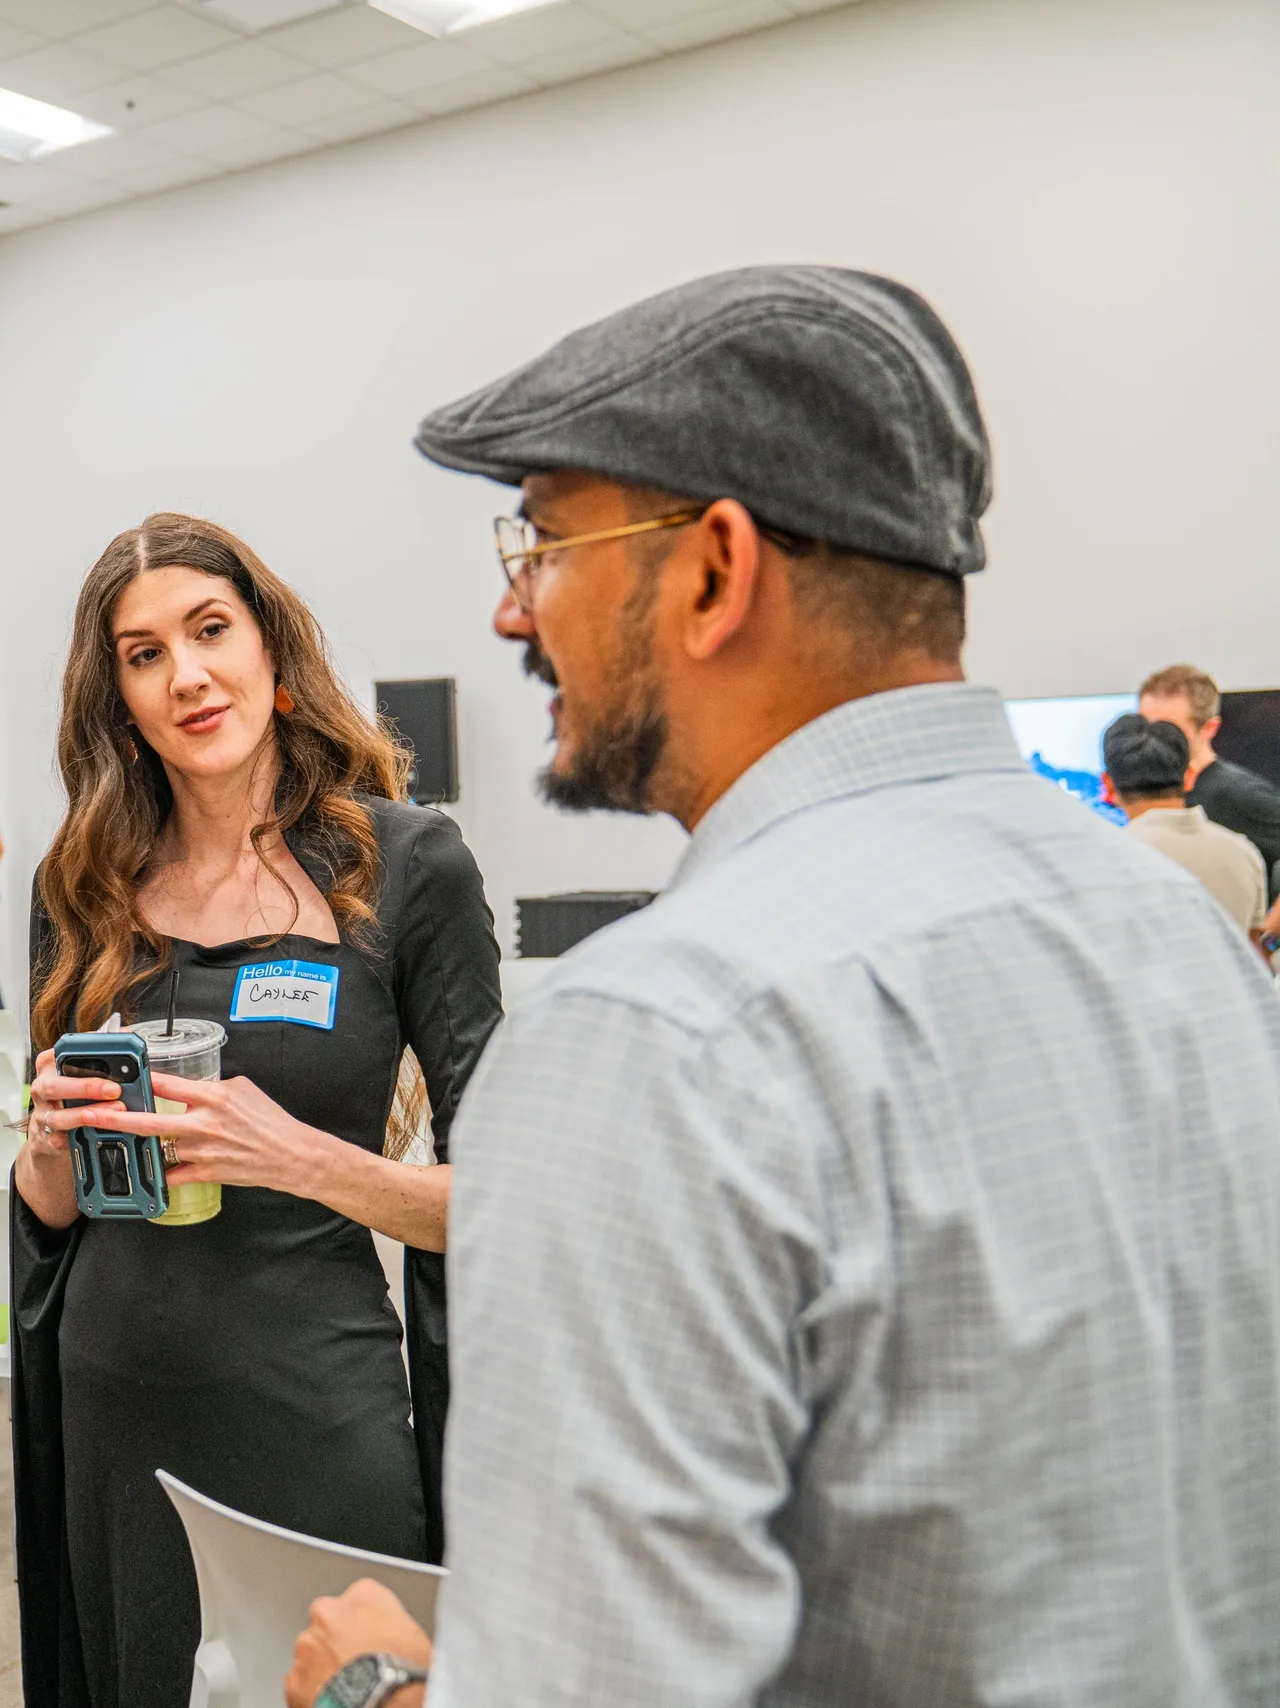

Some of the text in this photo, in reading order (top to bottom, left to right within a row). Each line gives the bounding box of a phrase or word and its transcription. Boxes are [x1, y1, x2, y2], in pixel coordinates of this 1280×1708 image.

[242, 964, 327, 981] Hello my name is
[249, 983, 319, 1002] CAYLEE
